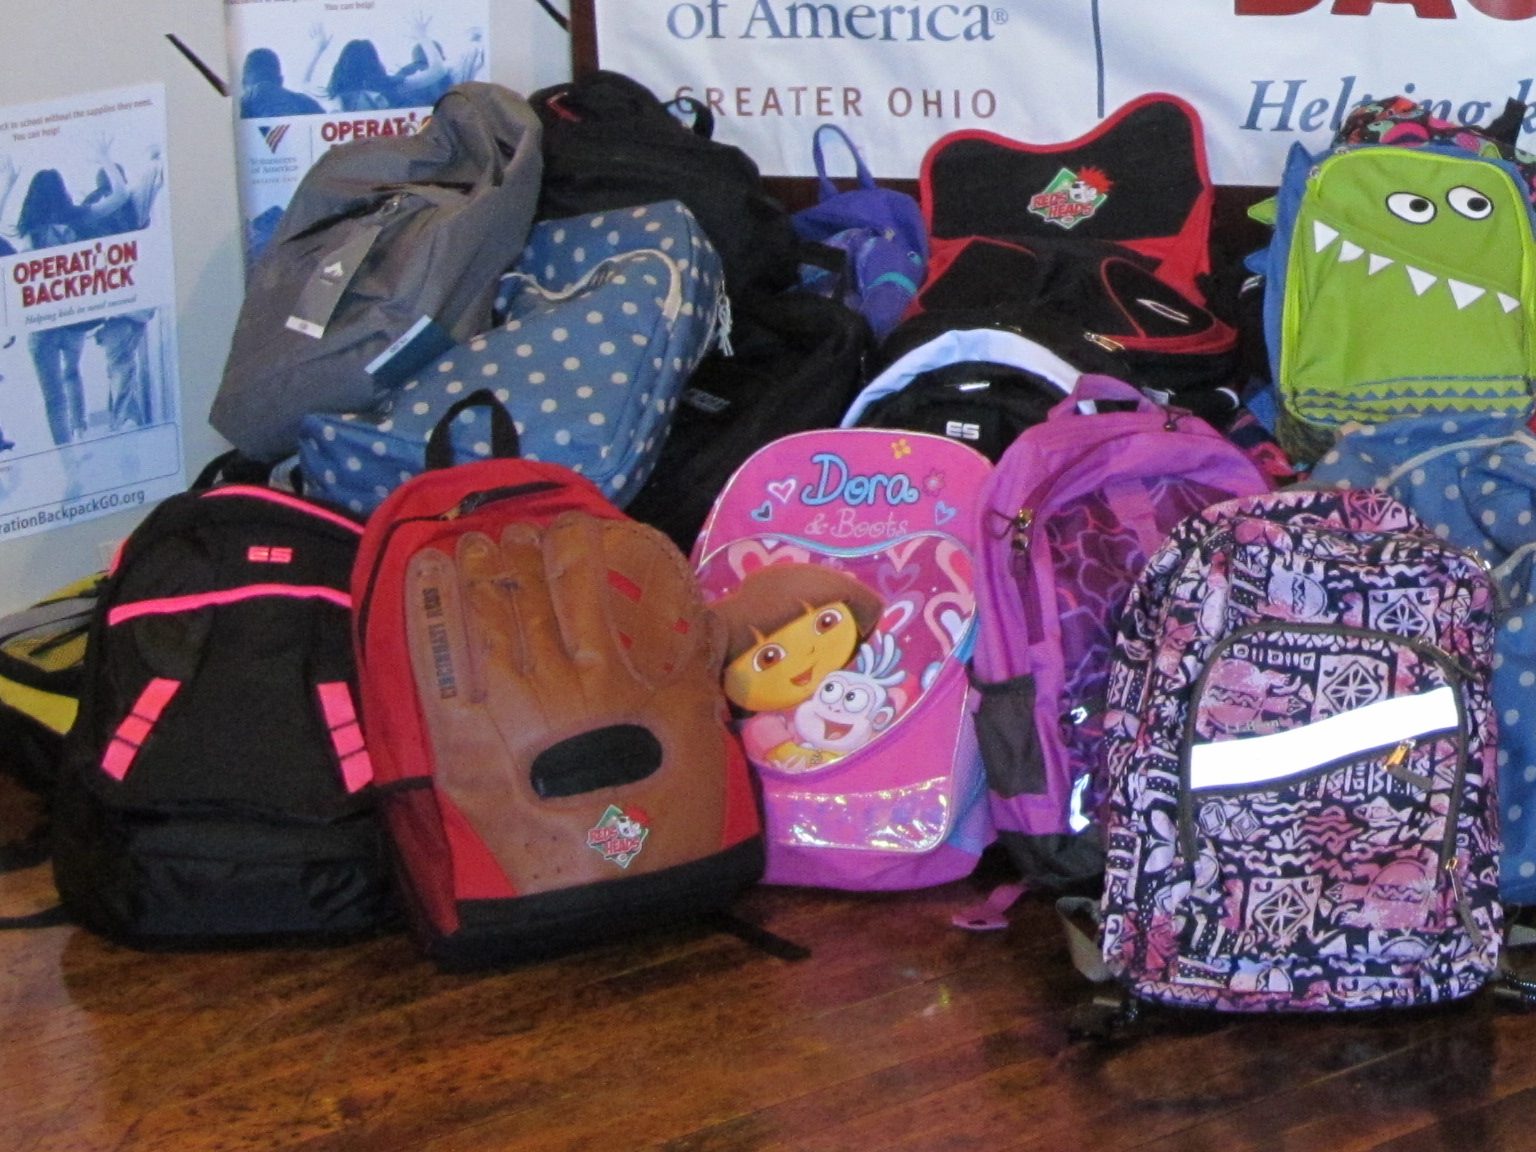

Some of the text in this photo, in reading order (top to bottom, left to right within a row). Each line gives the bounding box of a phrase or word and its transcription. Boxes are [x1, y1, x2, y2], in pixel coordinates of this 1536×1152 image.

[674, 86, 997, 118] GREATER OHIO
[1047, 202, 1095, 218] HEADS
[945, 420, 980, 440] ES
[800, 452, 921, 507] Dora
[829, 506, 909, 538] Boots
[248, 545, 293, 563] ES
